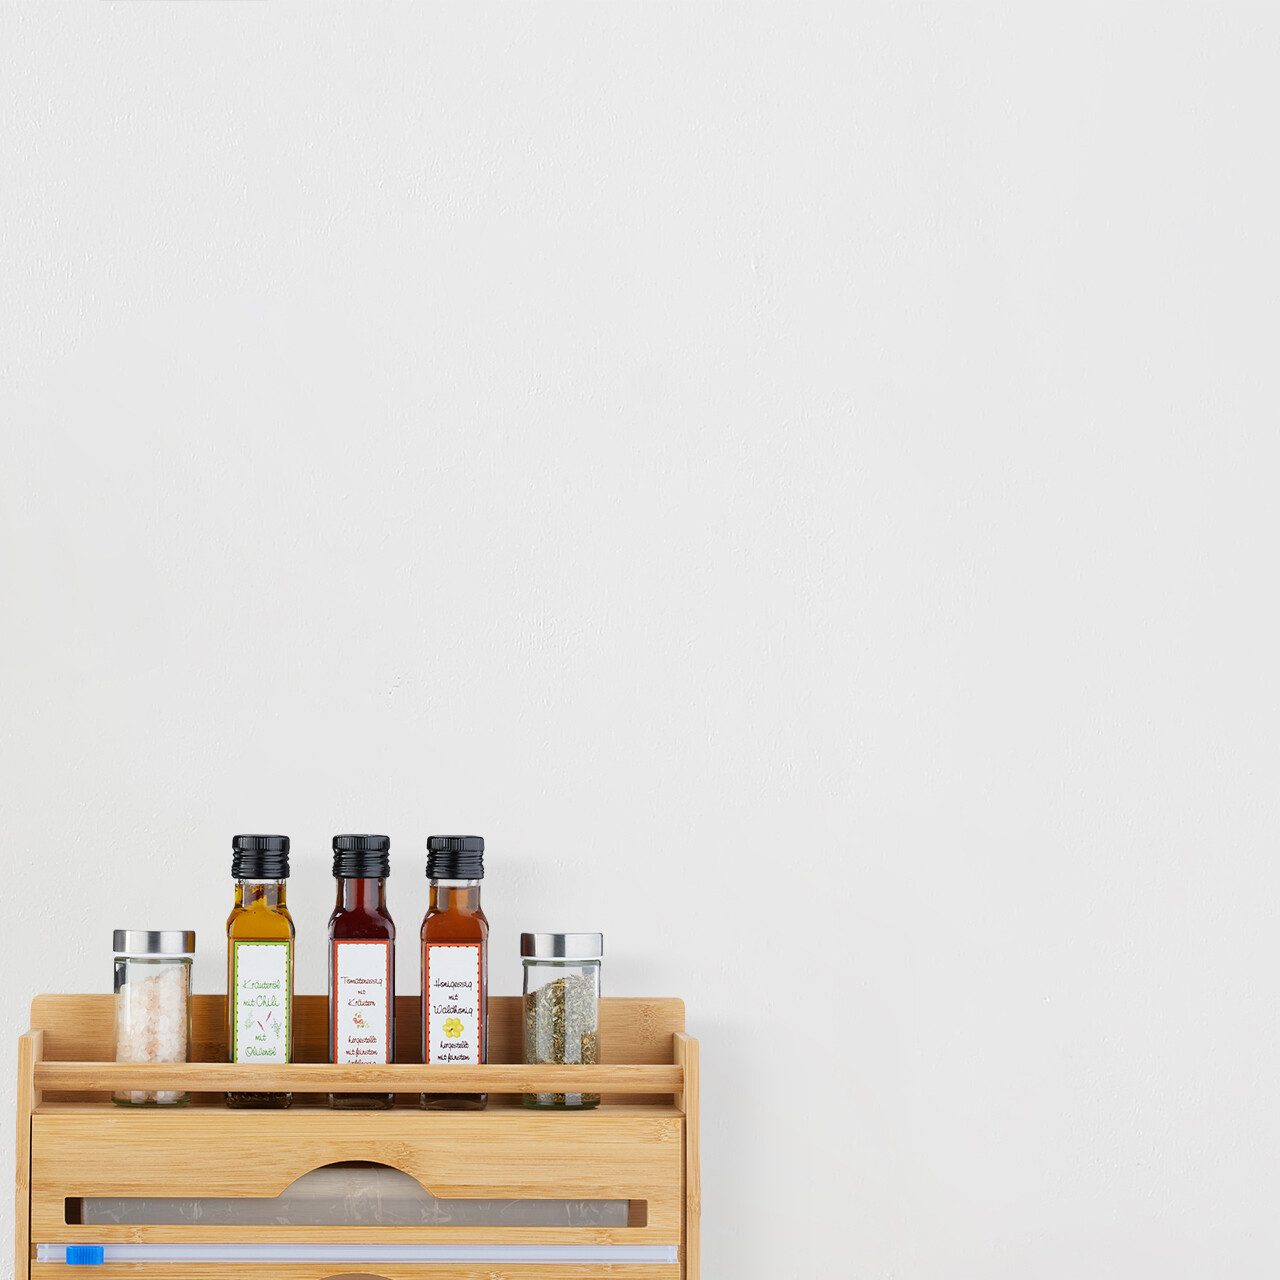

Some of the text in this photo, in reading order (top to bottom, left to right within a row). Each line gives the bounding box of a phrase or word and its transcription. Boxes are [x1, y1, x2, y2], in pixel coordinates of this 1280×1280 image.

[242, 995, 280, 1007] mit Chili
[448, 993, 459, 1001] mit
[433, 1004, 474, 1018] Waldhonig
[254, 1033, 267, 1042] mit
